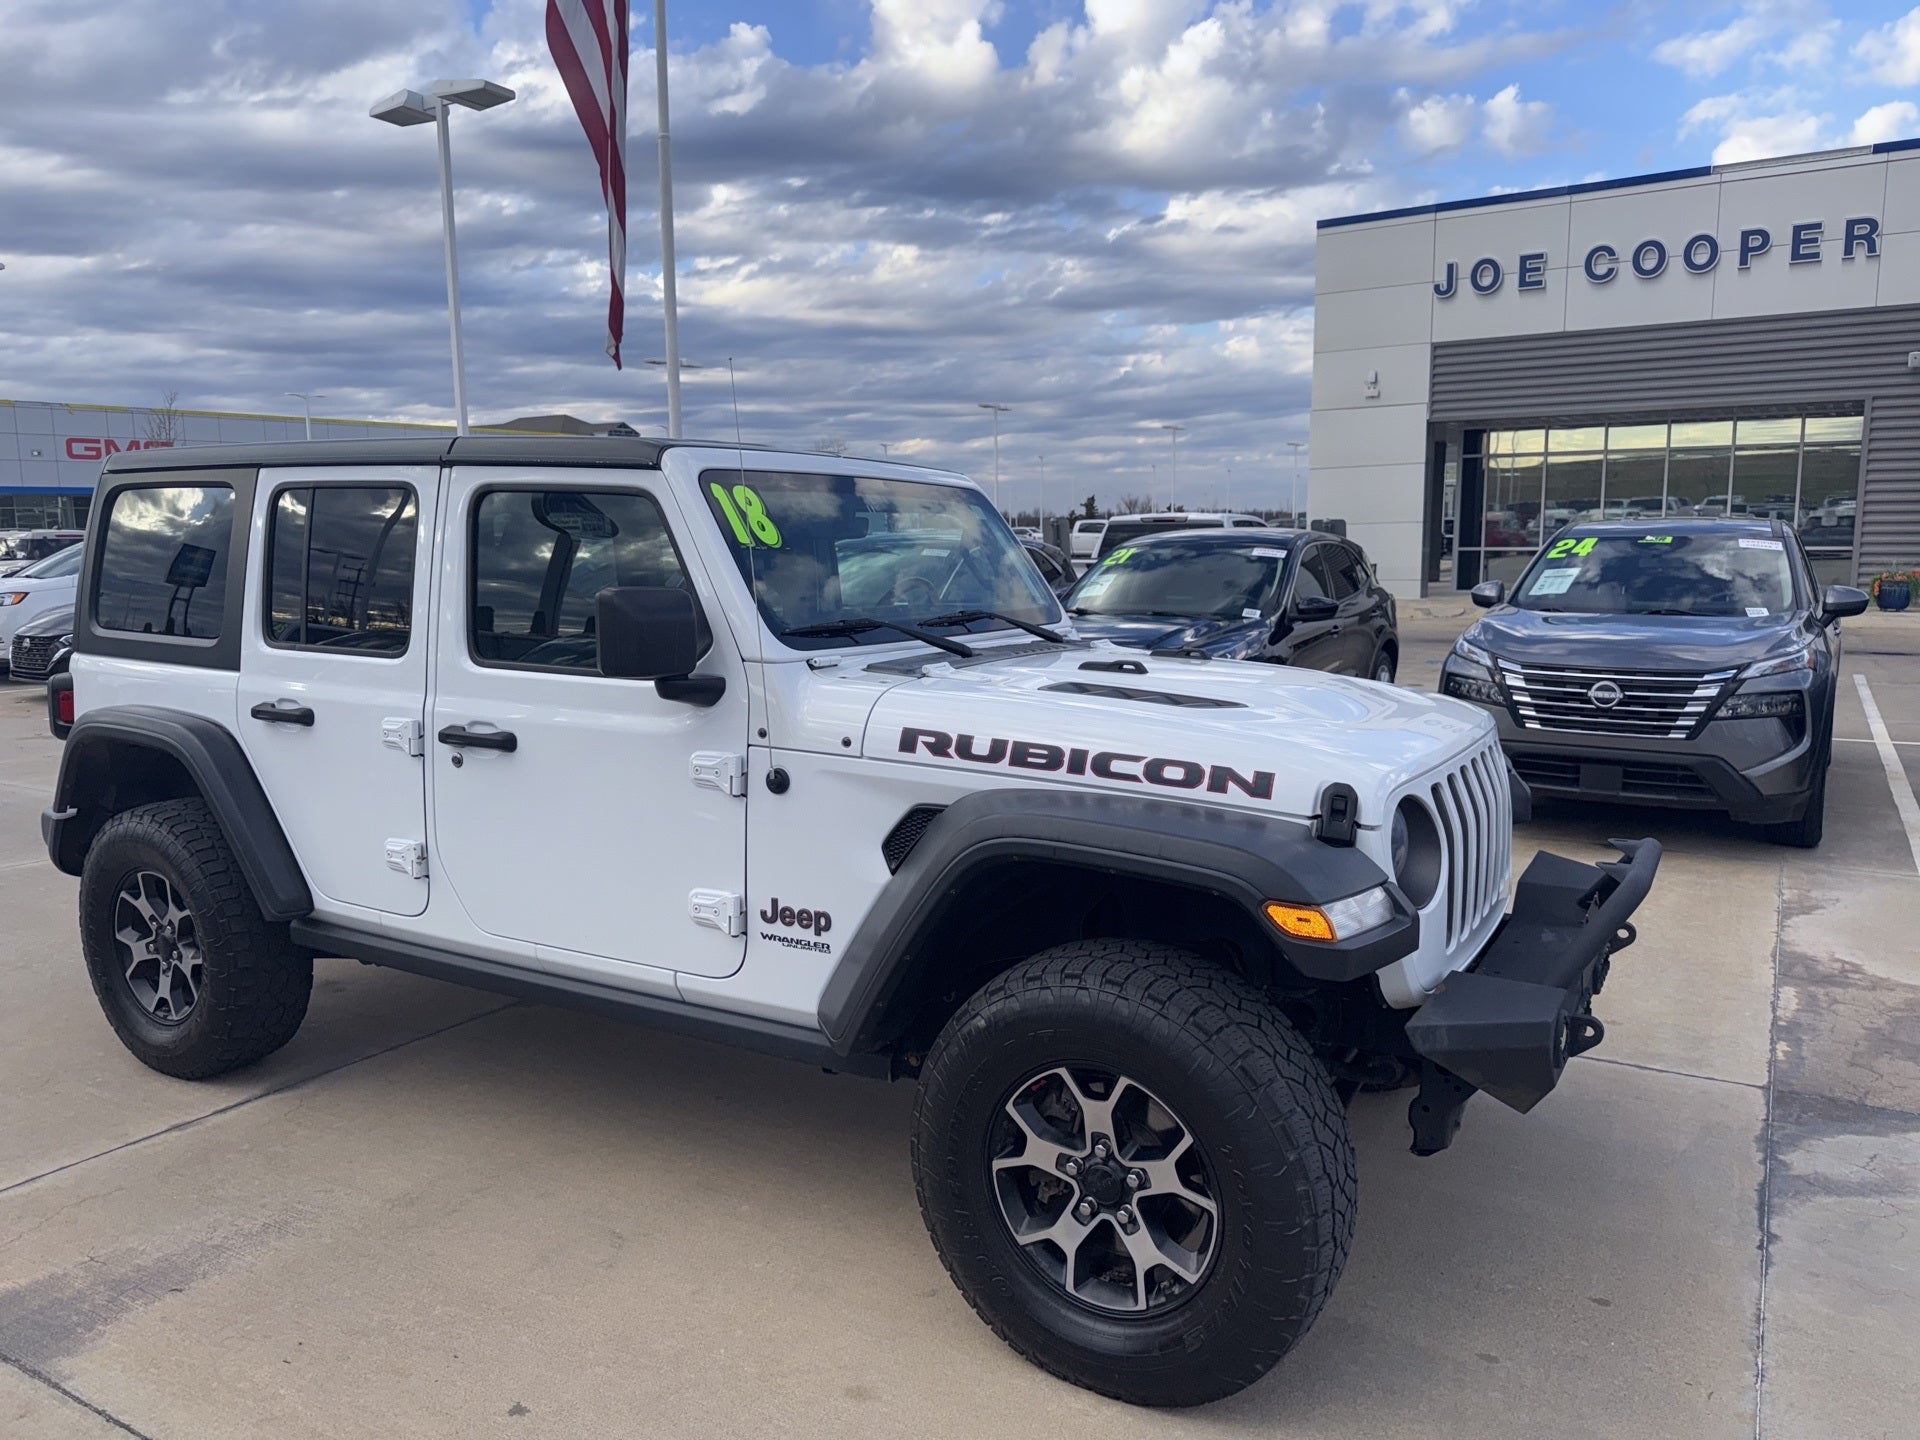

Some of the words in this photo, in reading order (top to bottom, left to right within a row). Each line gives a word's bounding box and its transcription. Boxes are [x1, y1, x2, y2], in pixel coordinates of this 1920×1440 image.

[1433, 252, 1547, 298] JOE
[1584, 217, 1881, 284] COOPER
[710, 483, 782, 548] 18
[1103, 547, 1137, 566] 21
[1546, 537, 1598, 559] 24
[898, 726, 1276, 800] RUBICON
[760, 897, 832, 936] Jeep
[760, 932, 831, 950] WRANGLER
[782, 942, 831, 954] UNLIMITED
